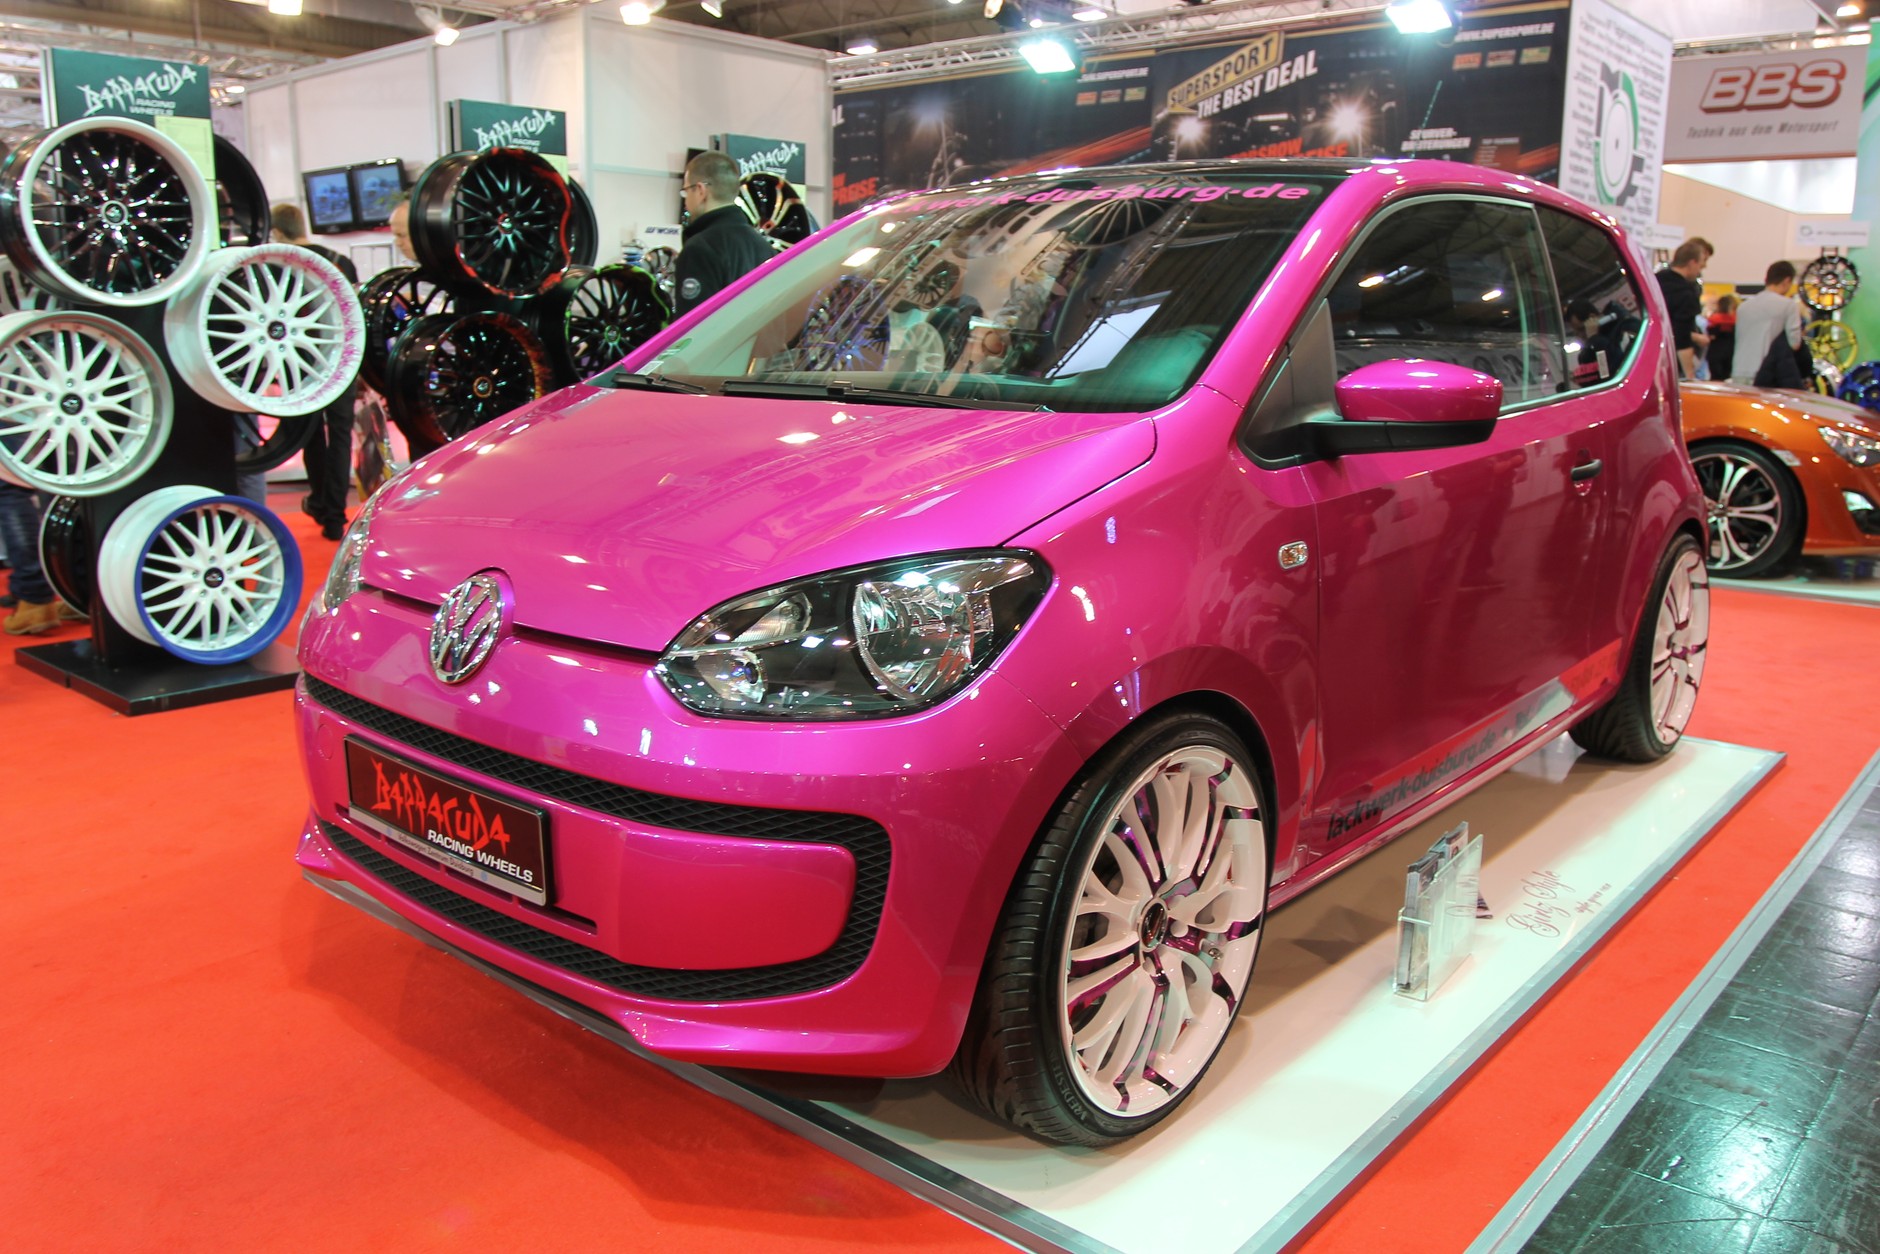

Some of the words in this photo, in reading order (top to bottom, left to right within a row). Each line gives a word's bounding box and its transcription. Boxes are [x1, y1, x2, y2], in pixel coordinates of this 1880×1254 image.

[75, 63, 198, 117] BARRACUDA
[1169, 36, 1276, 107] SUPERSPORT
[1197, 91, 1221, 119] THE
[1221, 74, 1264, 110] BEST
[1263, 50, 1318, 93] DEAL
[1700, 59, 1846, 114] BBS
[1687, 126, 1725, 139] Technik
[1728, 125, 1747, 137] aus
[1751, 123, 1773, 135] dem
[1778, 120, 1840, 134] Motorsport
[371, 756, 510, 856] BARRACUDA
[427, 829, 474, 858] RACING
[476, 849, 533, 883] WHEELS
